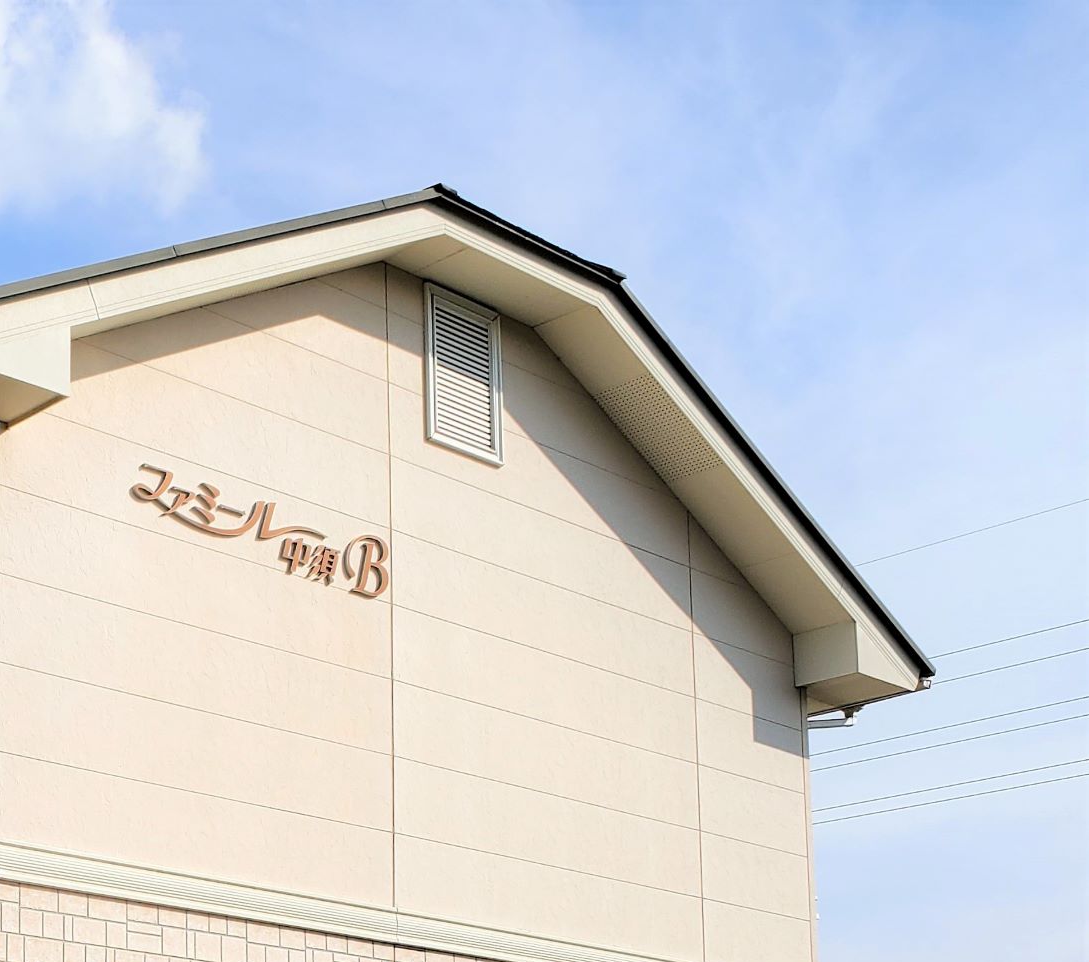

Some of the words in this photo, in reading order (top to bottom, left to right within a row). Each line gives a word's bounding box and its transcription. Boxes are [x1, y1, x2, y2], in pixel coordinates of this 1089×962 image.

[130, 463, 327, 541] ファミール
[342, 534, 389, 600] B
